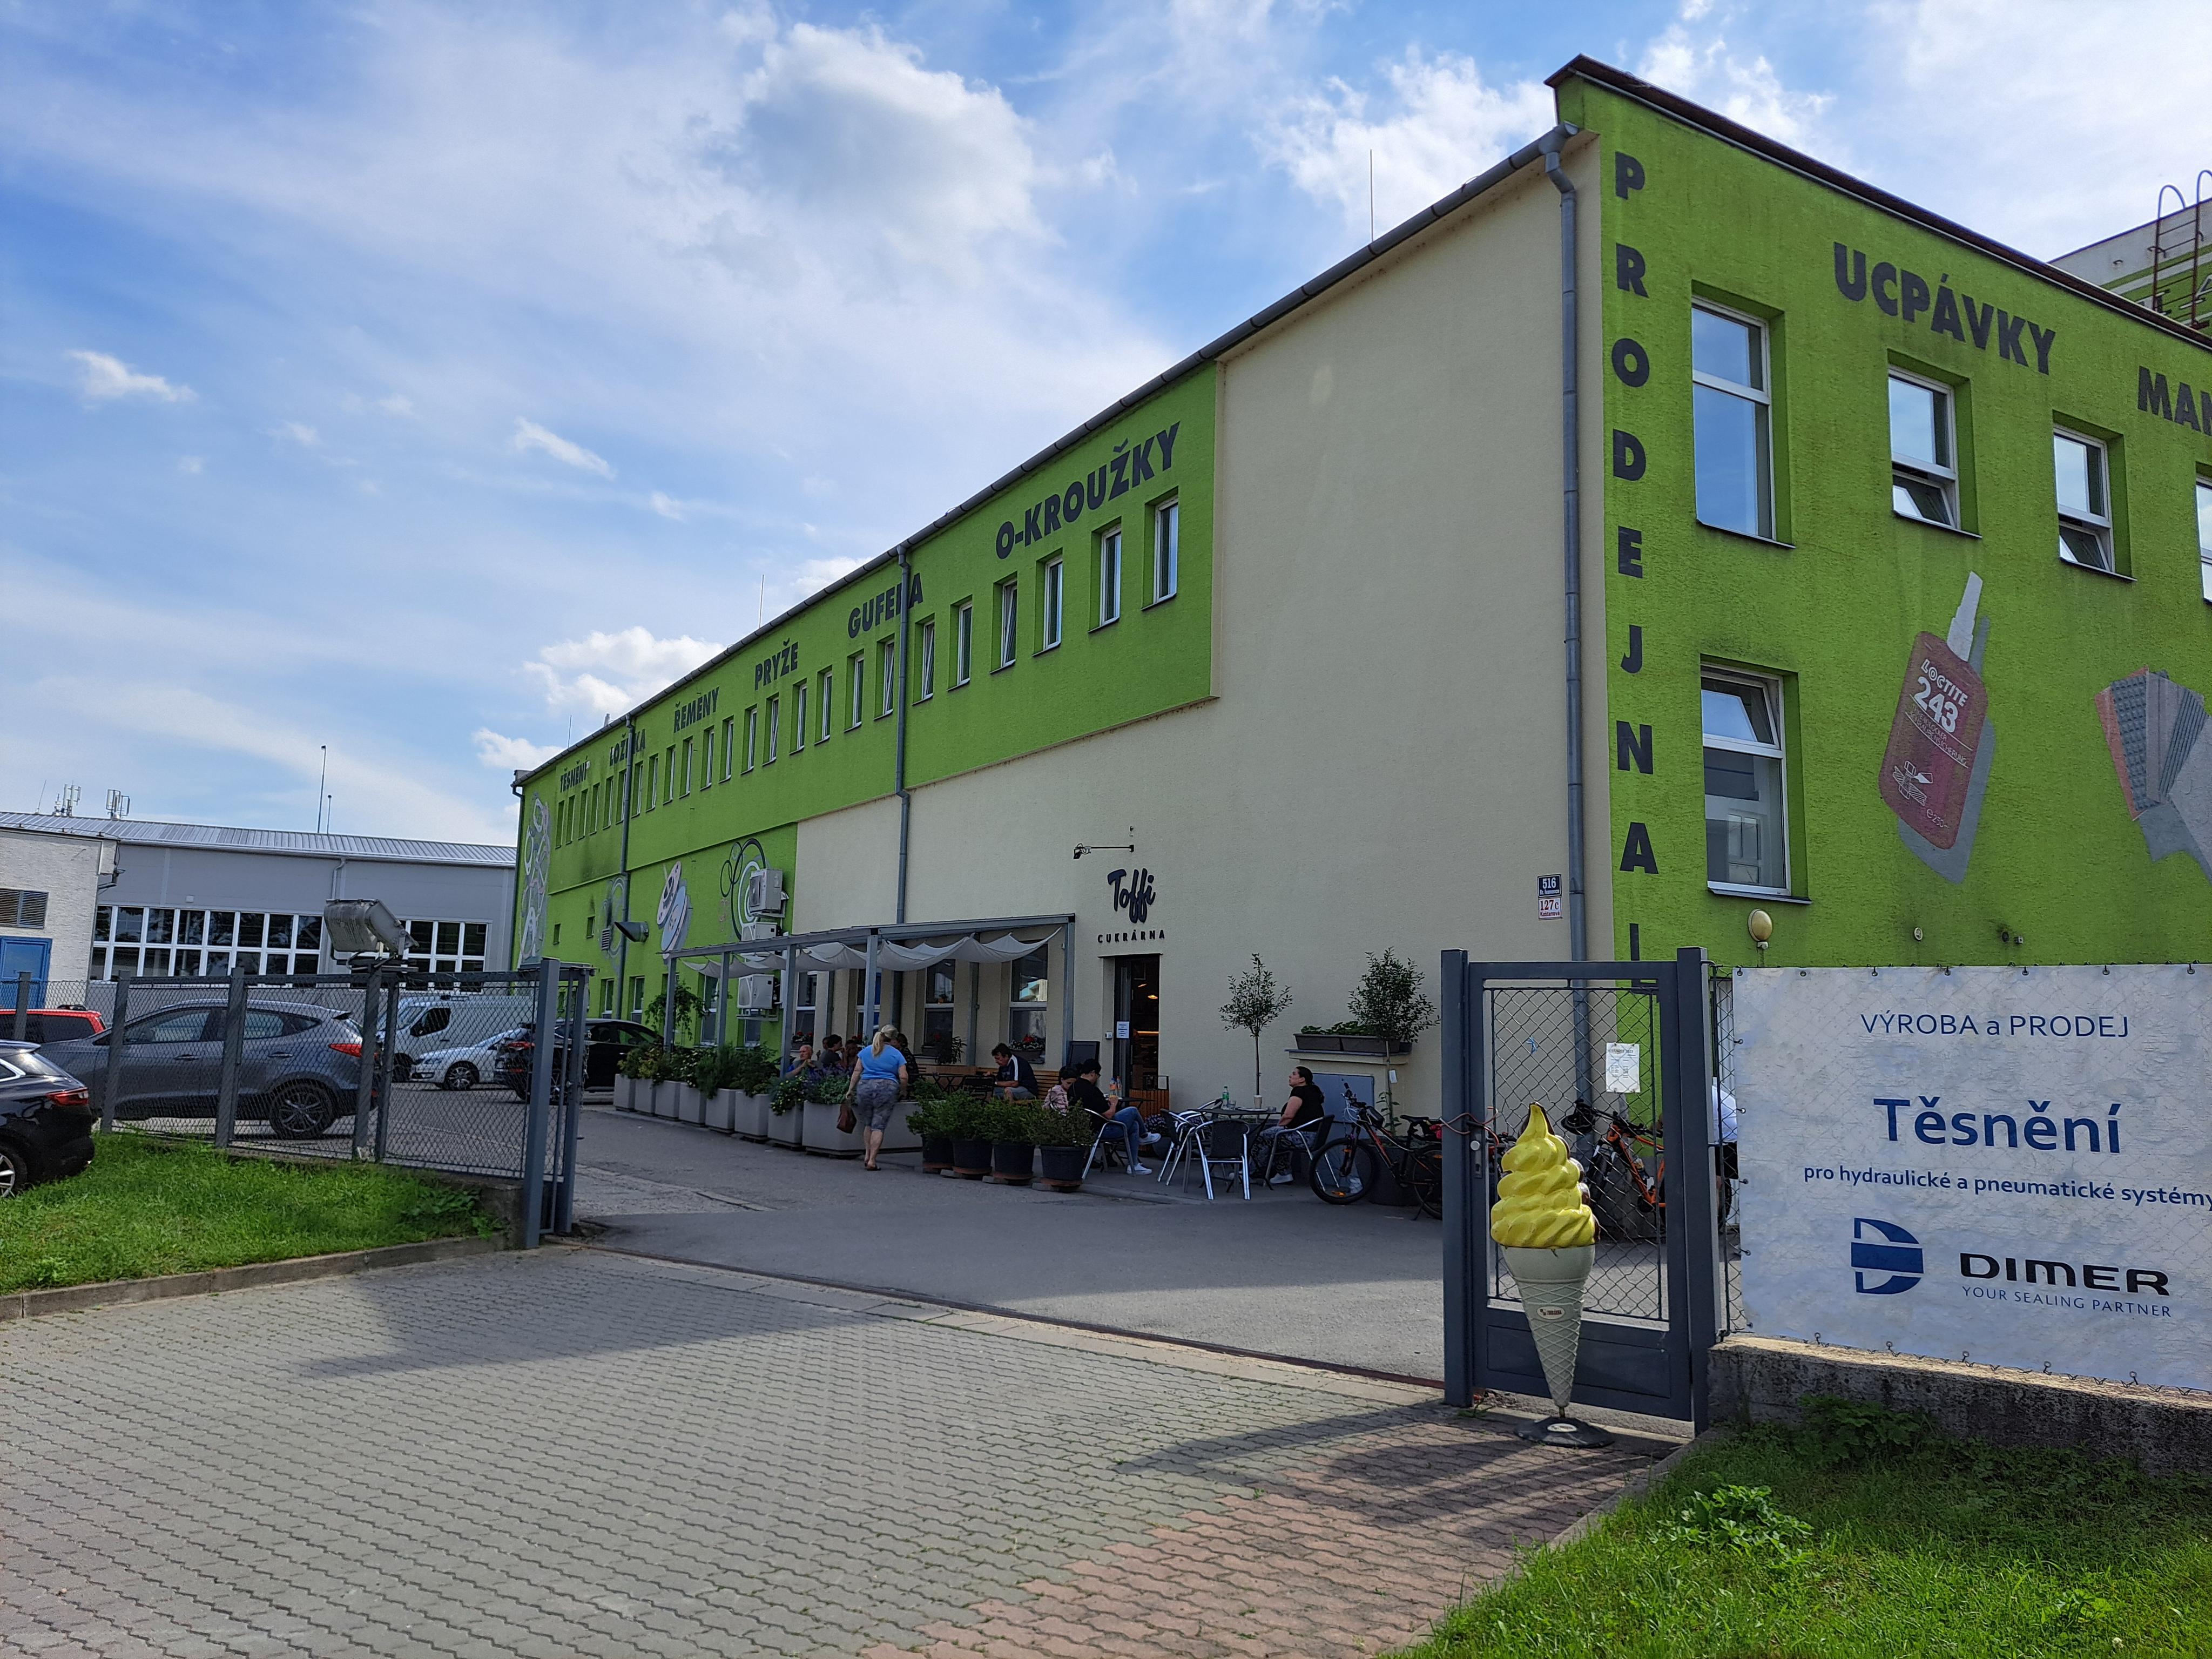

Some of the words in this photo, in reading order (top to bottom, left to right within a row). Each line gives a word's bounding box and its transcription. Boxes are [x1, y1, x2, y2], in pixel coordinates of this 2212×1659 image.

[1834, 241, 2056, 375] UCPÁVKY
[1611, 151, 1658, 874] PRODEJNA
[560, 756, 588, 793] TĚSNĚNÍ
[609, 729, 646, 766] LOŽIKA
[673, 686, 720, 733] ŘEMENY
[754, 637, 799, 691] PRYŽE
[996, 420, 1181, 559] O-KROUŽKY
[1913, 676, 1959, 733] 243
[1920, 658, 1968, 707] LOCTITE
[1107, 868, 1156, 923] Toffi
[1540, 900, 1559, 911] 127c
[1542, 877, 1556, 889] 516
[1097, 929, 1165, 943] CUKRÁRNA
[1861, 1009, 1979, 1035] VÝROBA
[1987, 1019, 2000, 1036] a
[2009, 1015, 2129, 1038] PRODEJ
[1873, 1095, 2122, 1154] Těsnění
[1804, 1166, 1835, 1183] pro
[1839, 1165, 1951, 1189] hydraulické
[1957, 1176, 1968, 1190] a
[1974, 1178, 2115, 1199] pneumatické
[1960, 1252, 2170, 1296] DIMER
[1962, 1286, 2008, 1301] YOUR
[2014, 1291, 2085, 1310] SEALING
[2092, 1299, 2172, 1318] PARTNER
